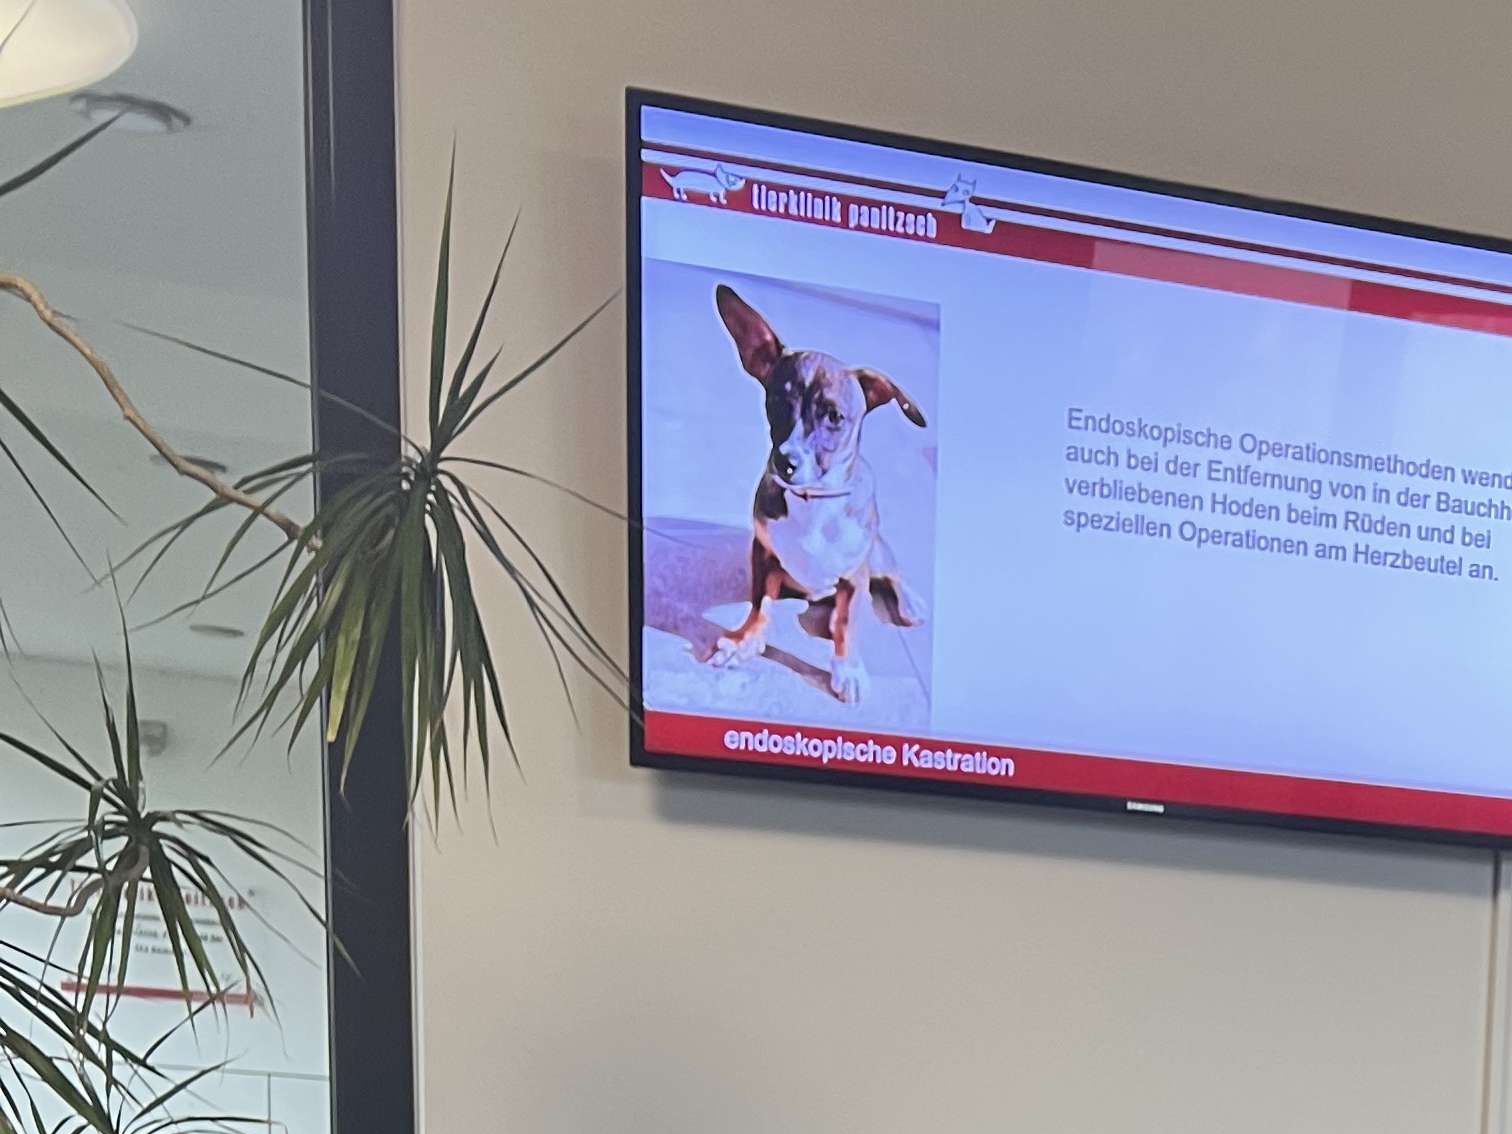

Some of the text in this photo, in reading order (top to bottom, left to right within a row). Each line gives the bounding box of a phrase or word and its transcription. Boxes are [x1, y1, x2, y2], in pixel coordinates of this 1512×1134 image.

[1065, 444, 1119, 467] auch
[1126, 449, 1159, 473] bei
[1165, 455, 1201, 478] der
[1207, 460, 1323, 500] Entfernung
[1329, 480, 1366, 501] von
[1372, 482, 1391, 504] in
[1396, 487, 1431, 509] der
[1067, 407, 1232, 450] Endoskopische
[1239, 433, 1456, 483] Operationsmethoden
[1063, 509, 1499, 582] speziellen Operationen am Herzbeutel an.
[1064, 477, 1492, 549] verbliebenen Hoden beim Rüden und bei
[723, 728, 1015, 777] endoskopische Kastration
